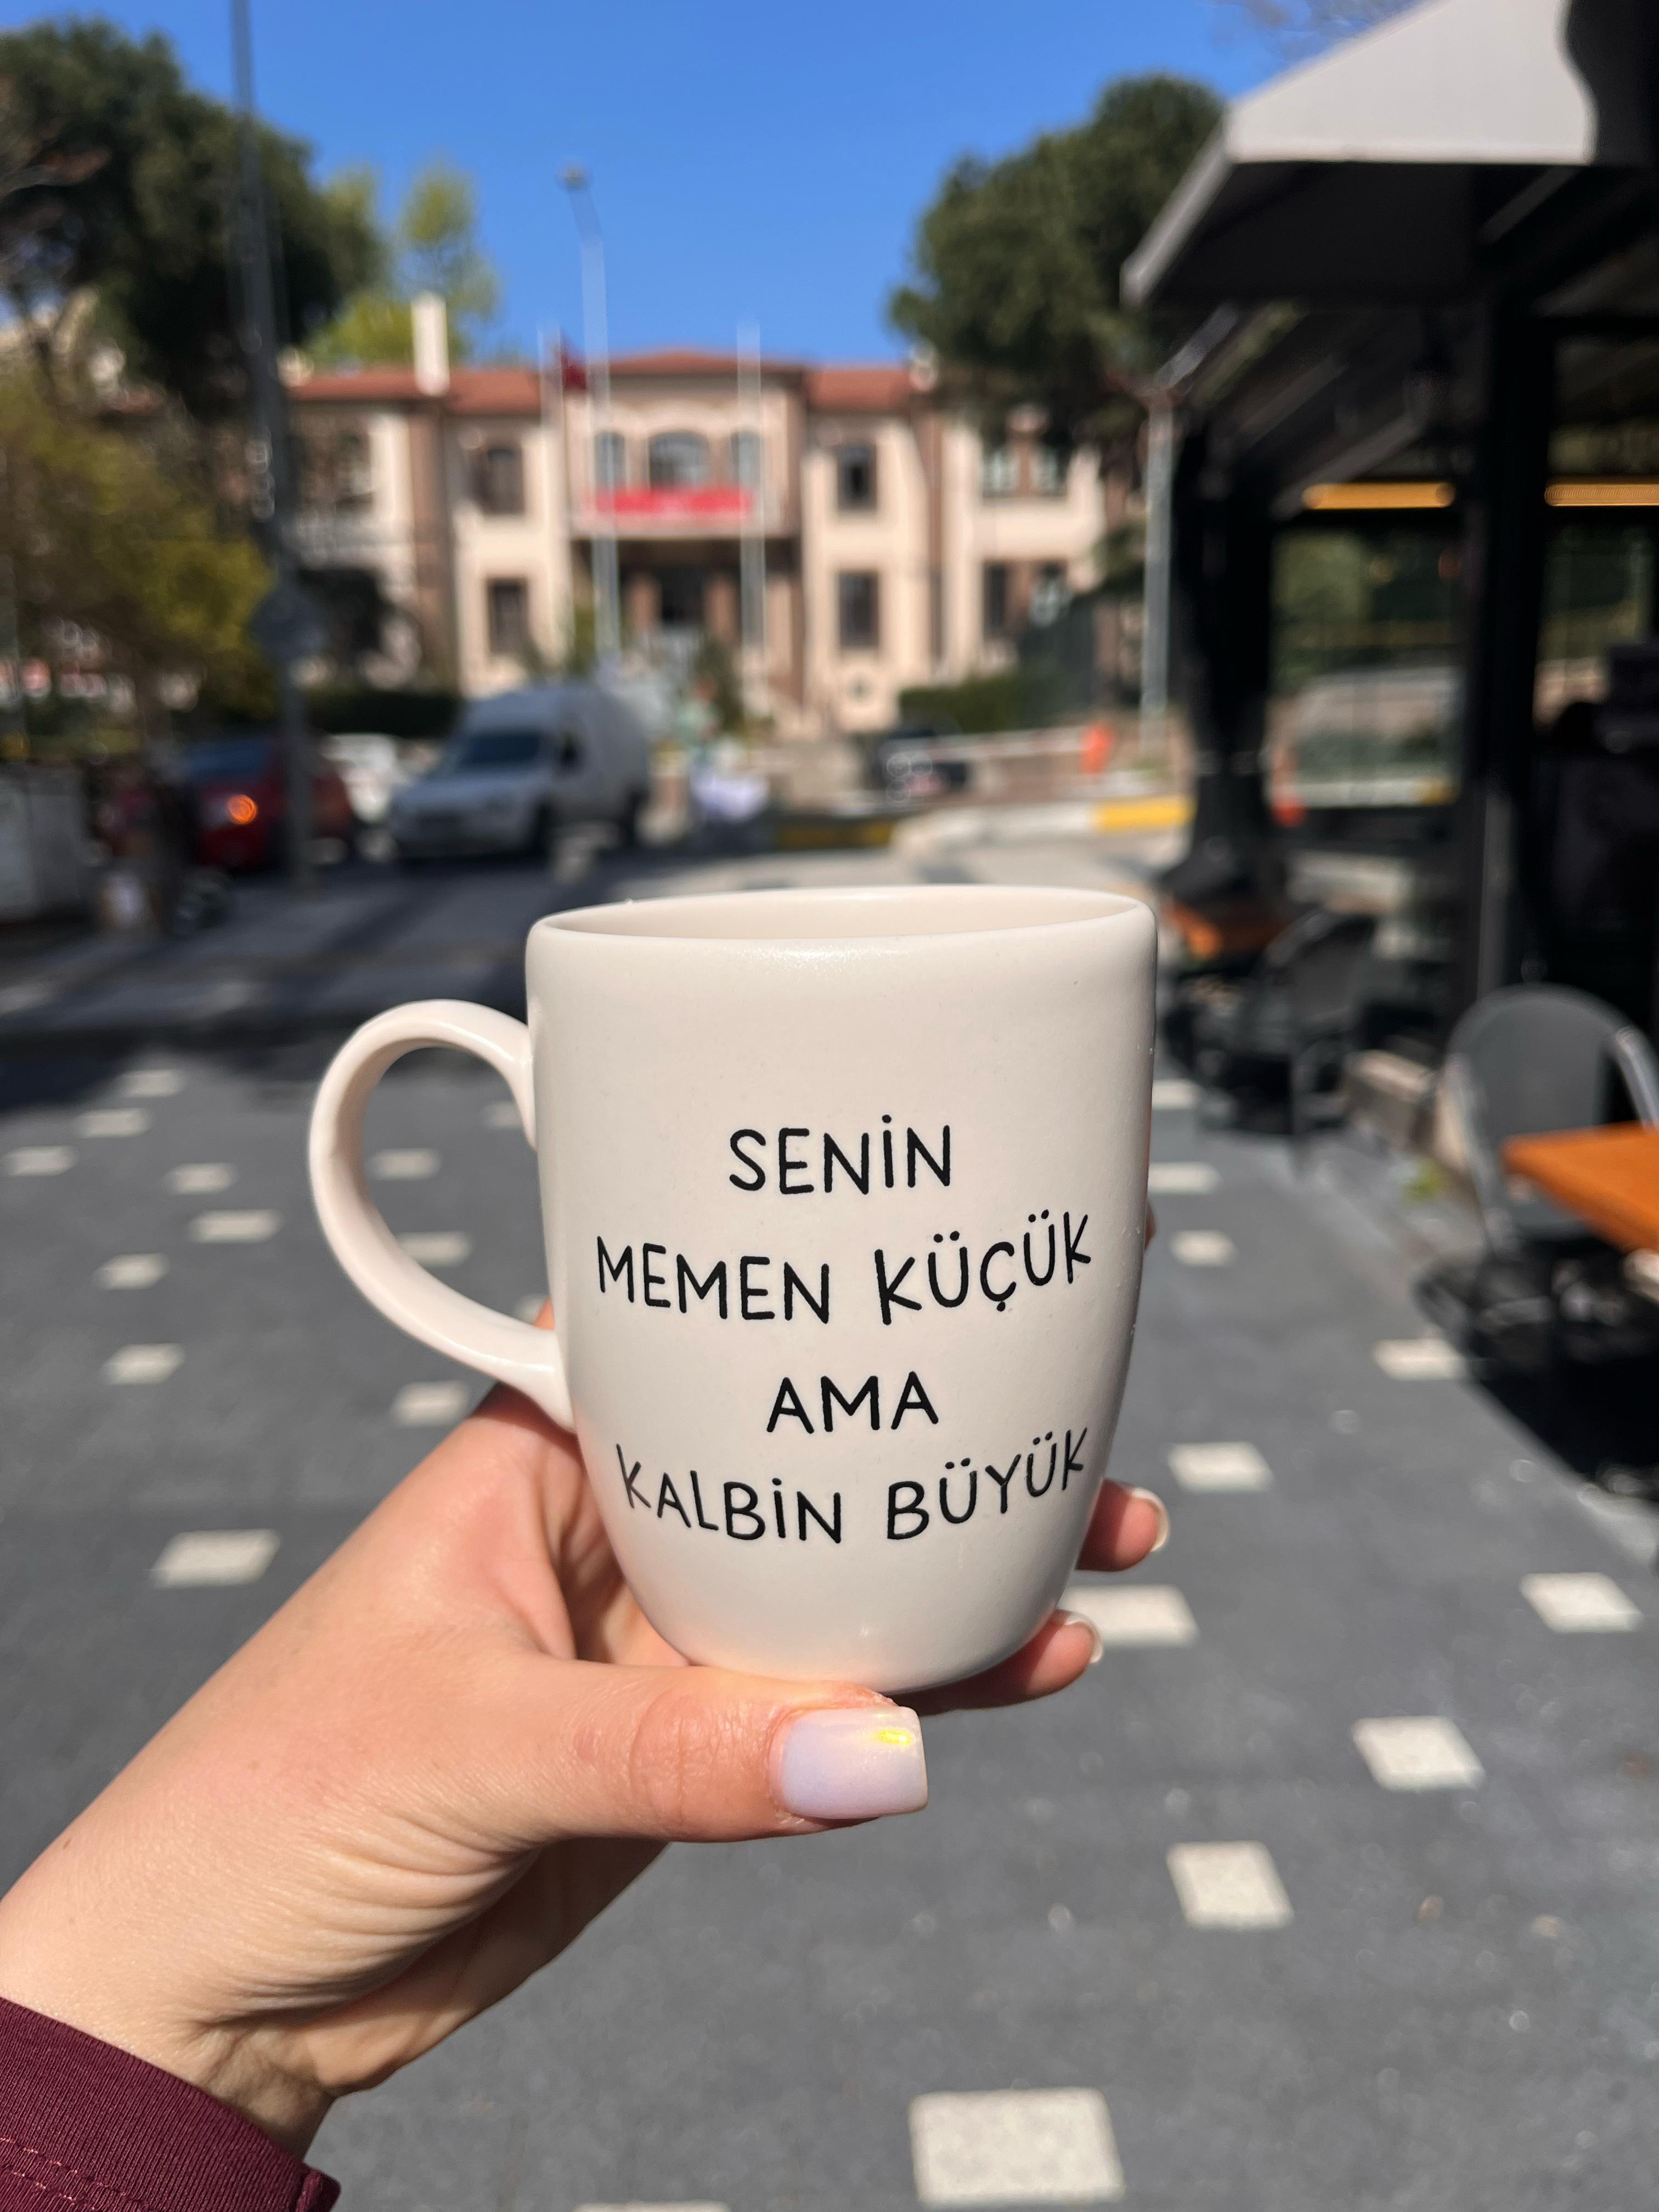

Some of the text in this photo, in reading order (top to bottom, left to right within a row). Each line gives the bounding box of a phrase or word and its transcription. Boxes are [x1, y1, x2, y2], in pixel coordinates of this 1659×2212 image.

[728, 1113, 952, 1197] SENİN
[596, 1207, 1092, 1327] MEMEN KÜÇÜK
[765, 1369, 940, 1436] AMA
[615, 1426, 1088, 1545] KALBİN BÜYÜK
